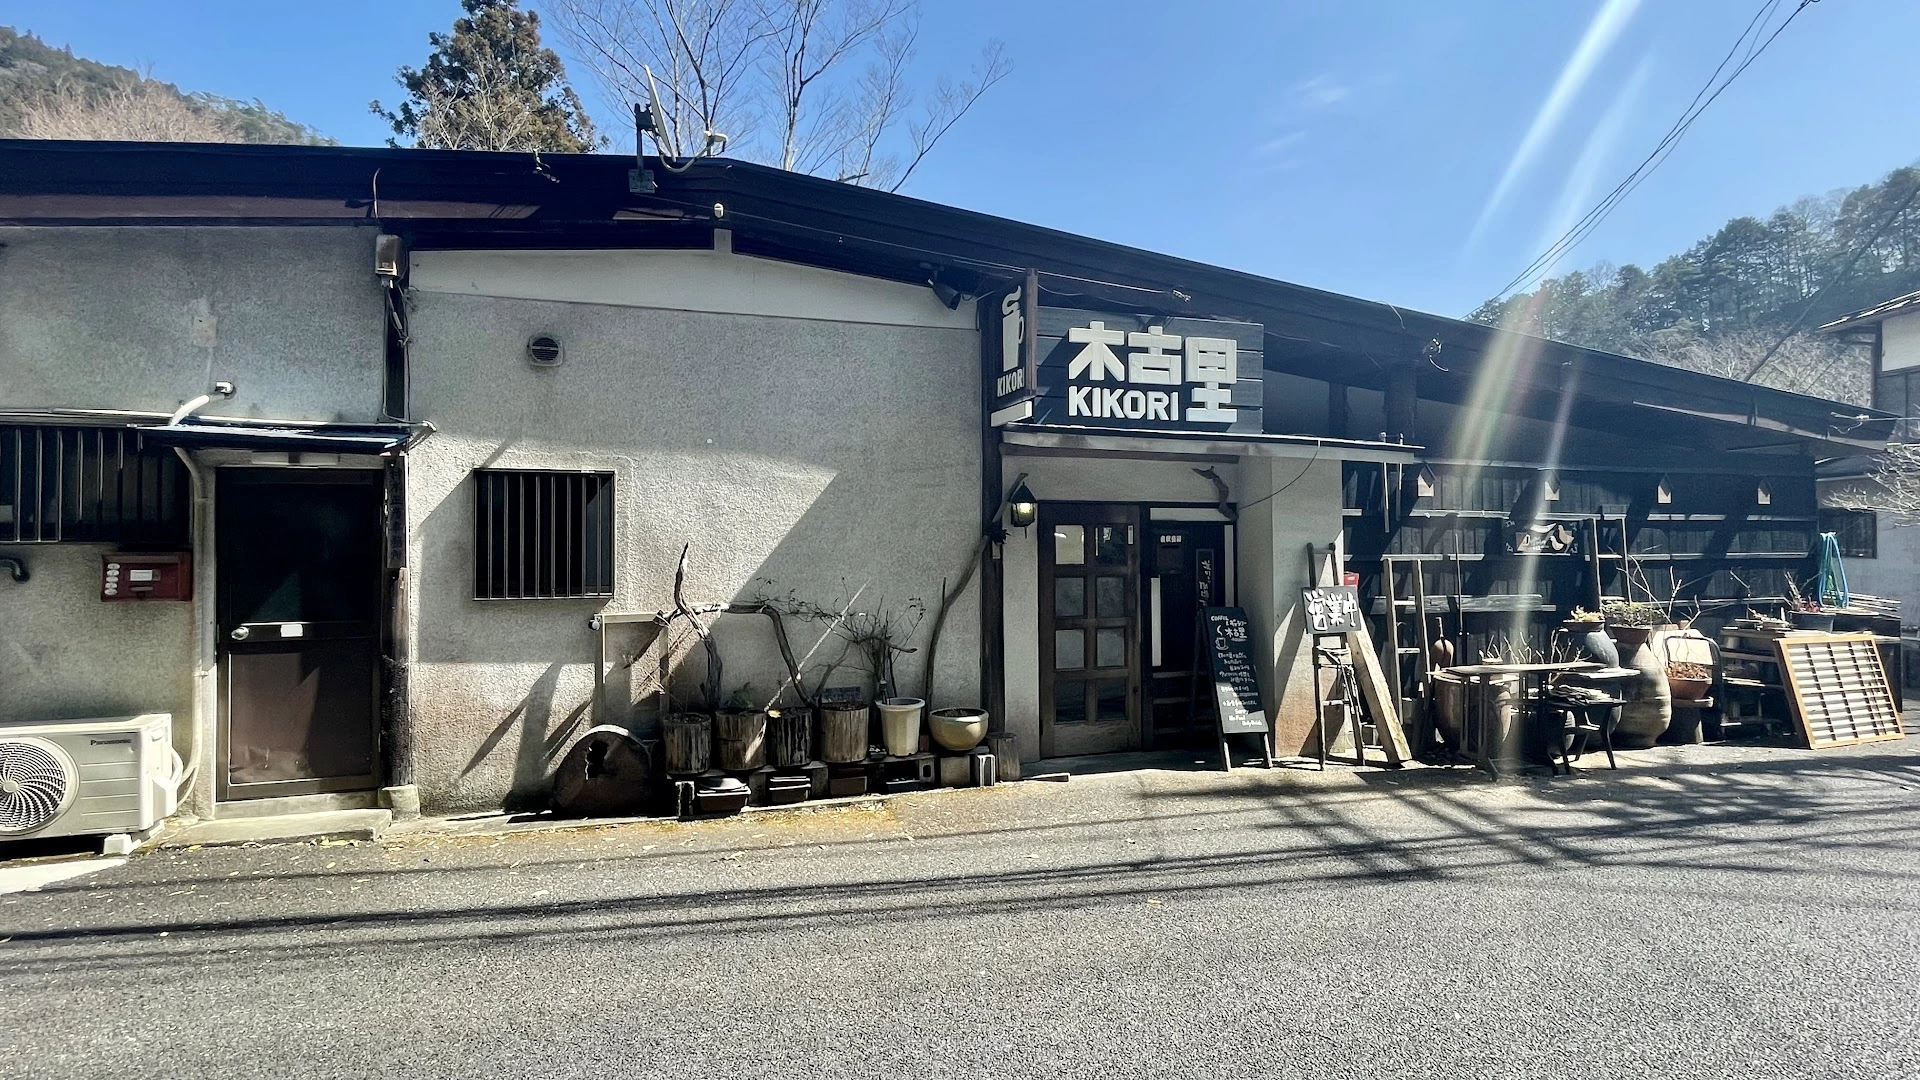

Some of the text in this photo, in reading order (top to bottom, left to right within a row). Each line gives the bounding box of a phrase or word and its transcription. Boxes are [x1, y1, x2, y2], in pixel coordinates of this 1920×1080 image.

[997, 366, 1025, 397] KIKORI
[1068, 321, 1238, 422] 木古里
[1068, 385, 1179, 421] KIKORI
[1304, 589, 1358, 631] 営業中
[90, 738, 132, 746] Panasonic
